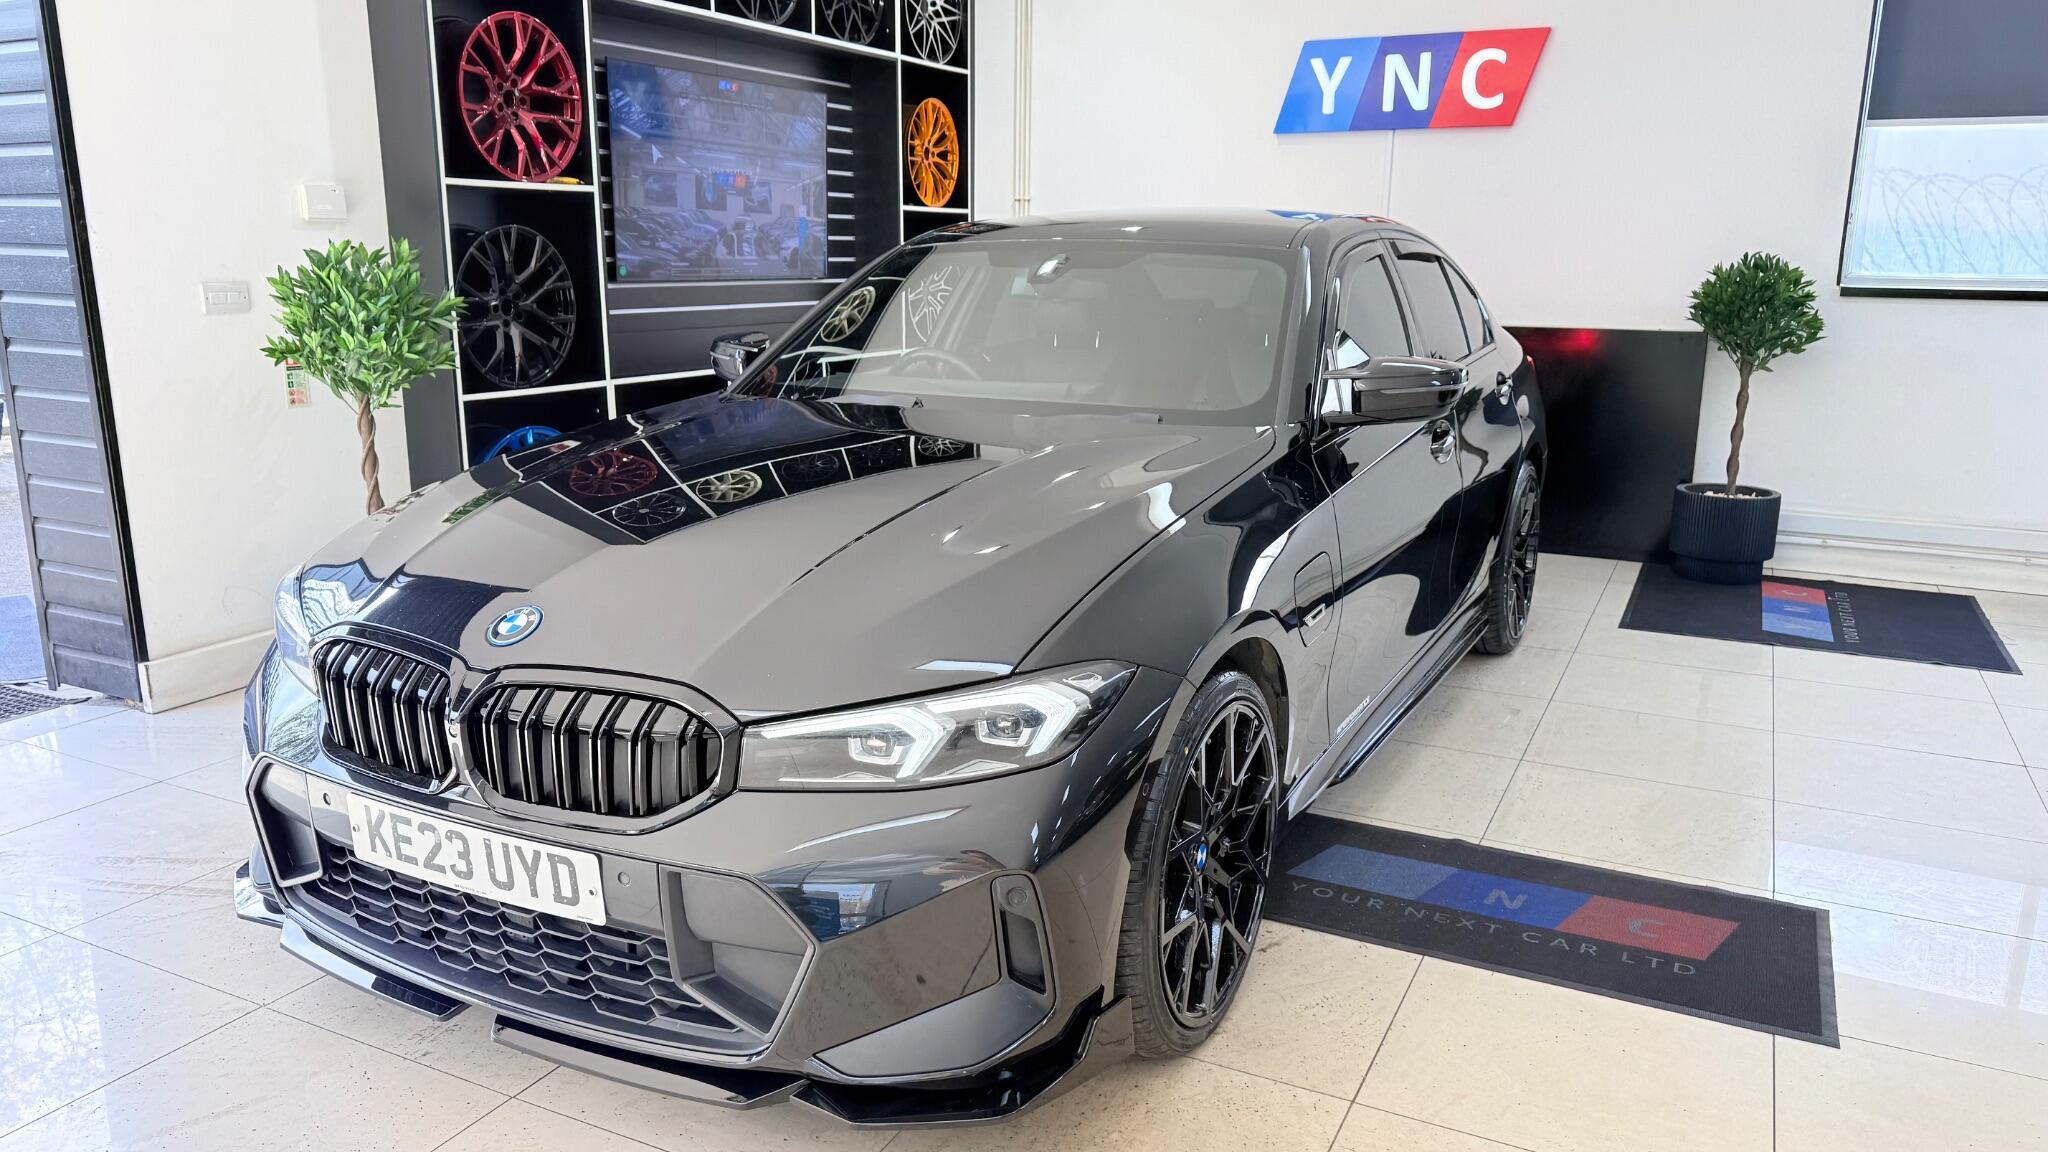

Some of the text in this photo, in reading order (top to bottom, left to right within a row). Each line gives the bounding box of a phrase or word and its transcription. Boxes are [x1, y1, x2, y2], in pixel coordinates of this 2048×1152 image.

[1310, 48, 1507, 115] YNC
[364, 804, 580, 907] KE23 UYD
[1291, 881, 1696, 976] YOUR NEXT CAR LTD
